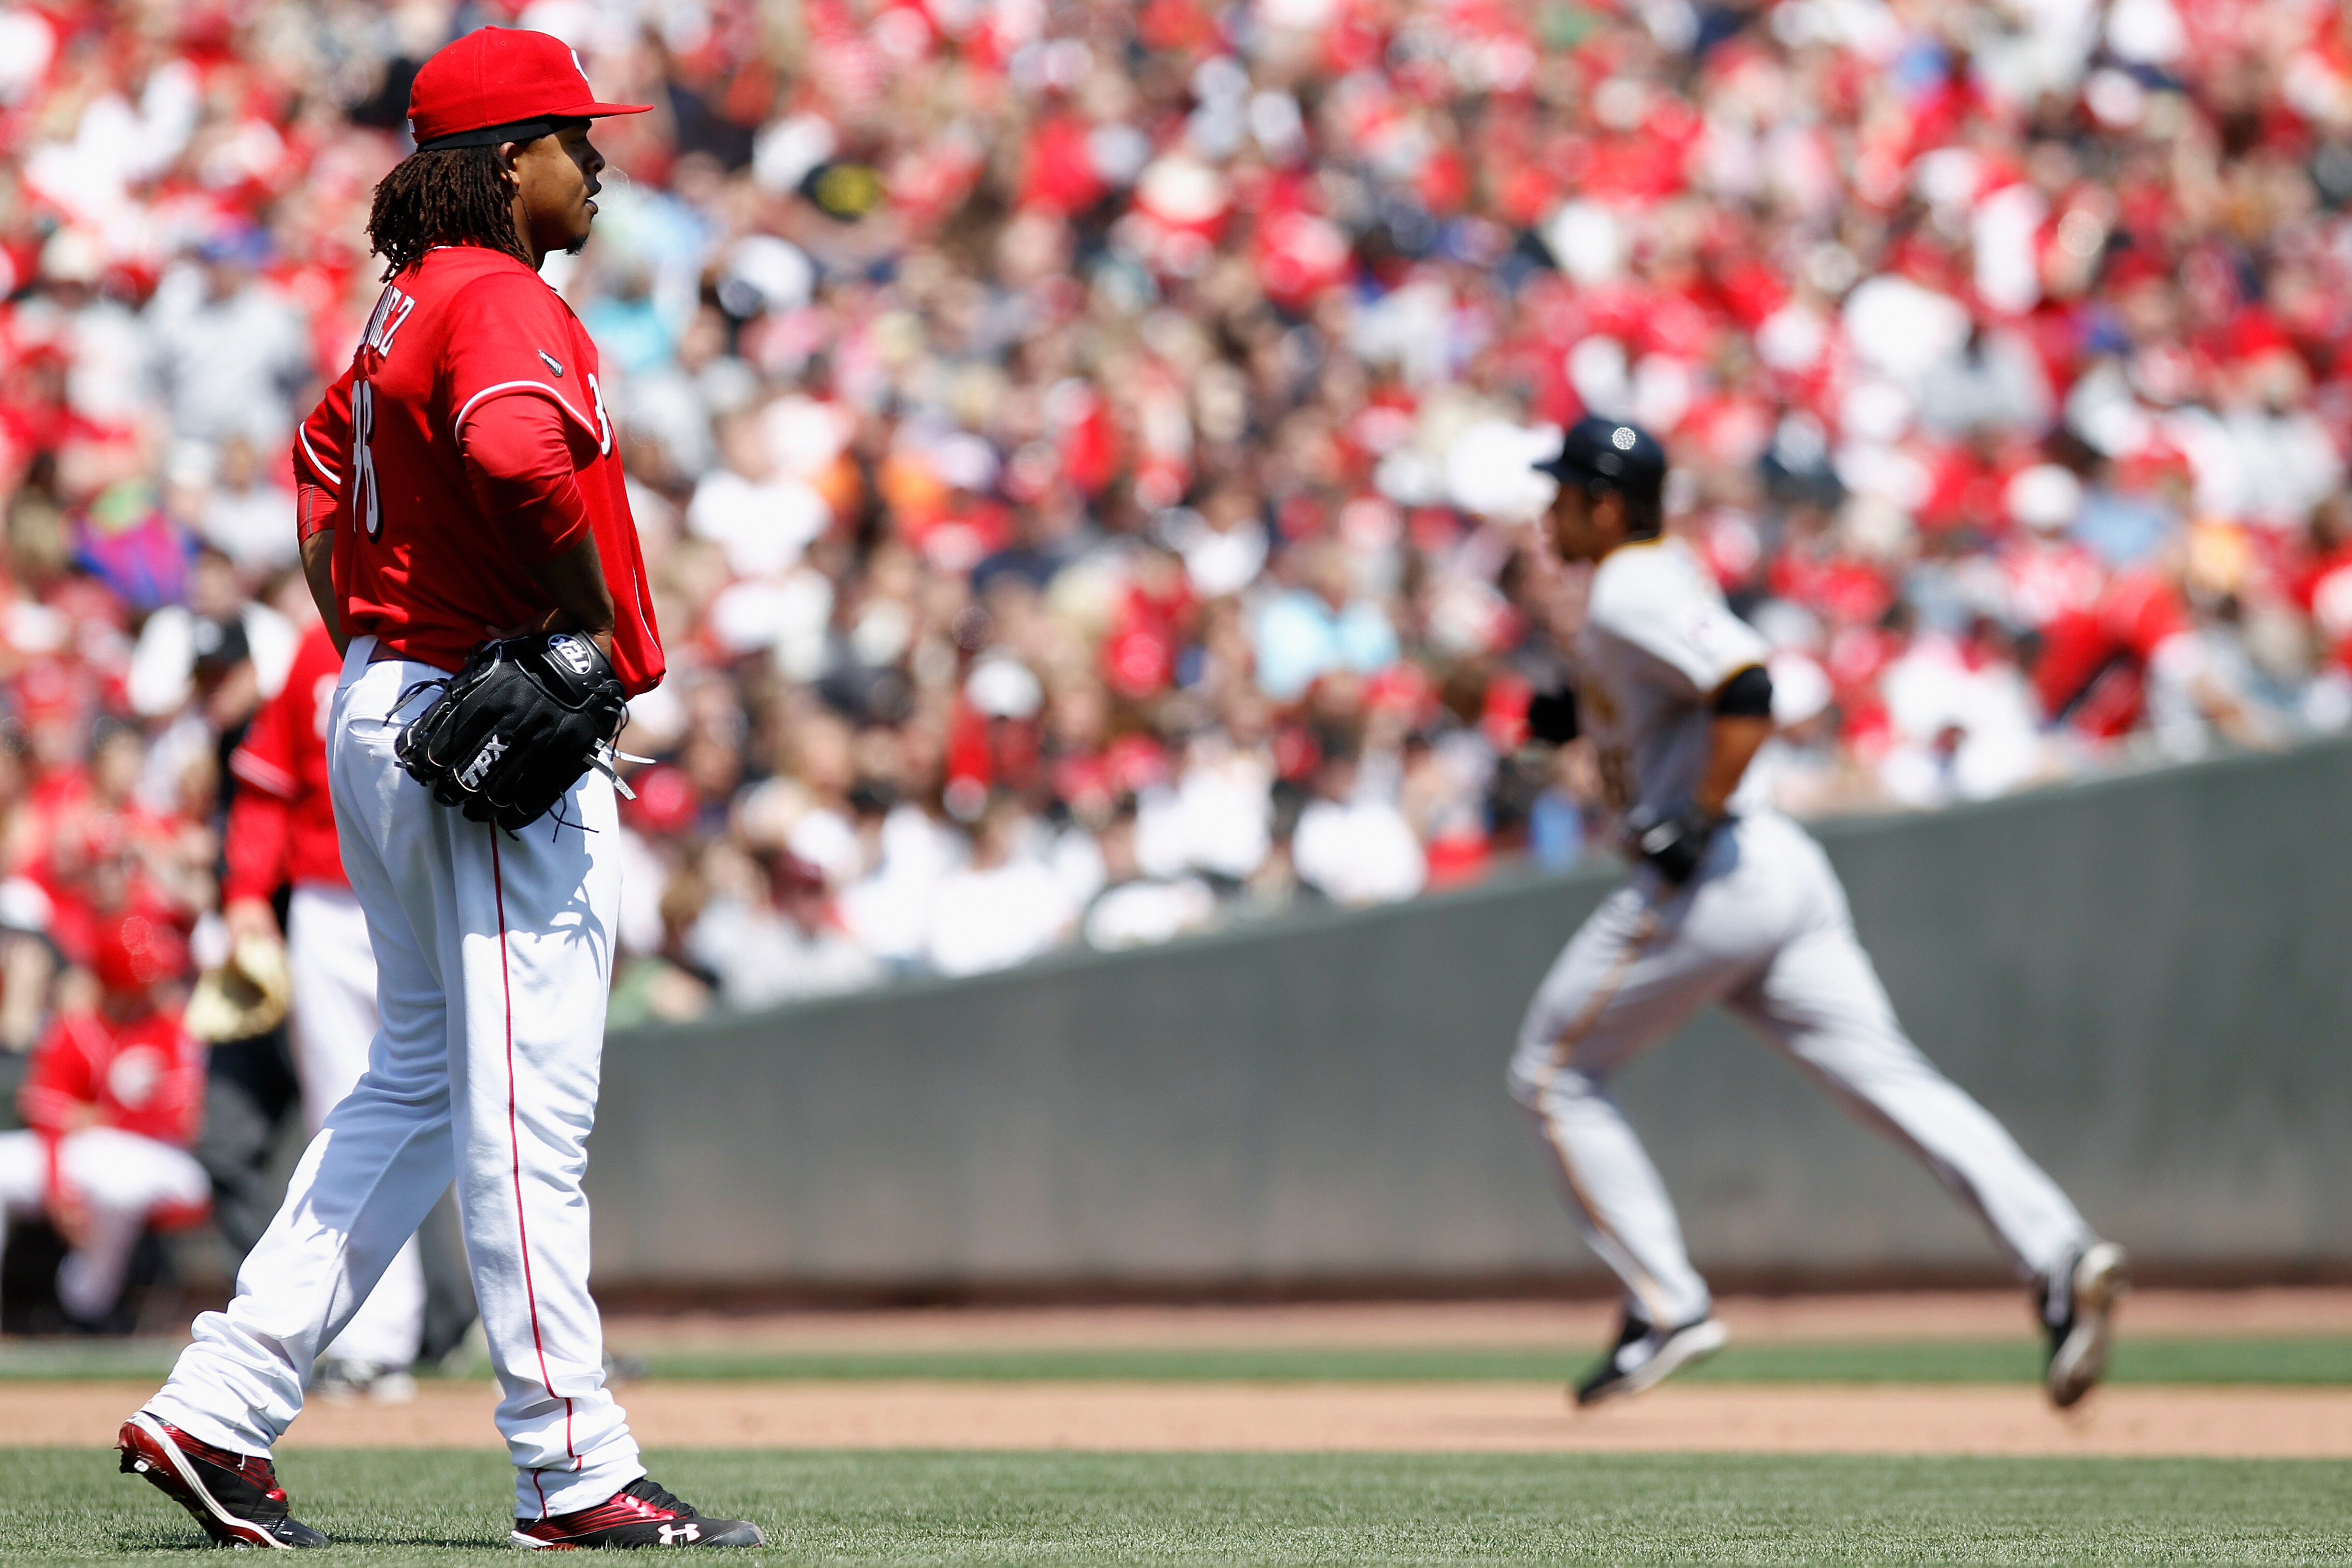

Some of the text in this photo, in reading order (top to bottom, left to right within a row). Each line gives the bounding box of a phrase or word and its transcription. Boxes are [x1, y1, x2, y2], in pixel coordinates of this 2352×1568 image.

[352, 380, 379, 534] 36
[550, 637, 589, 673] TPX
[460, 734, 509, 787] TPX
